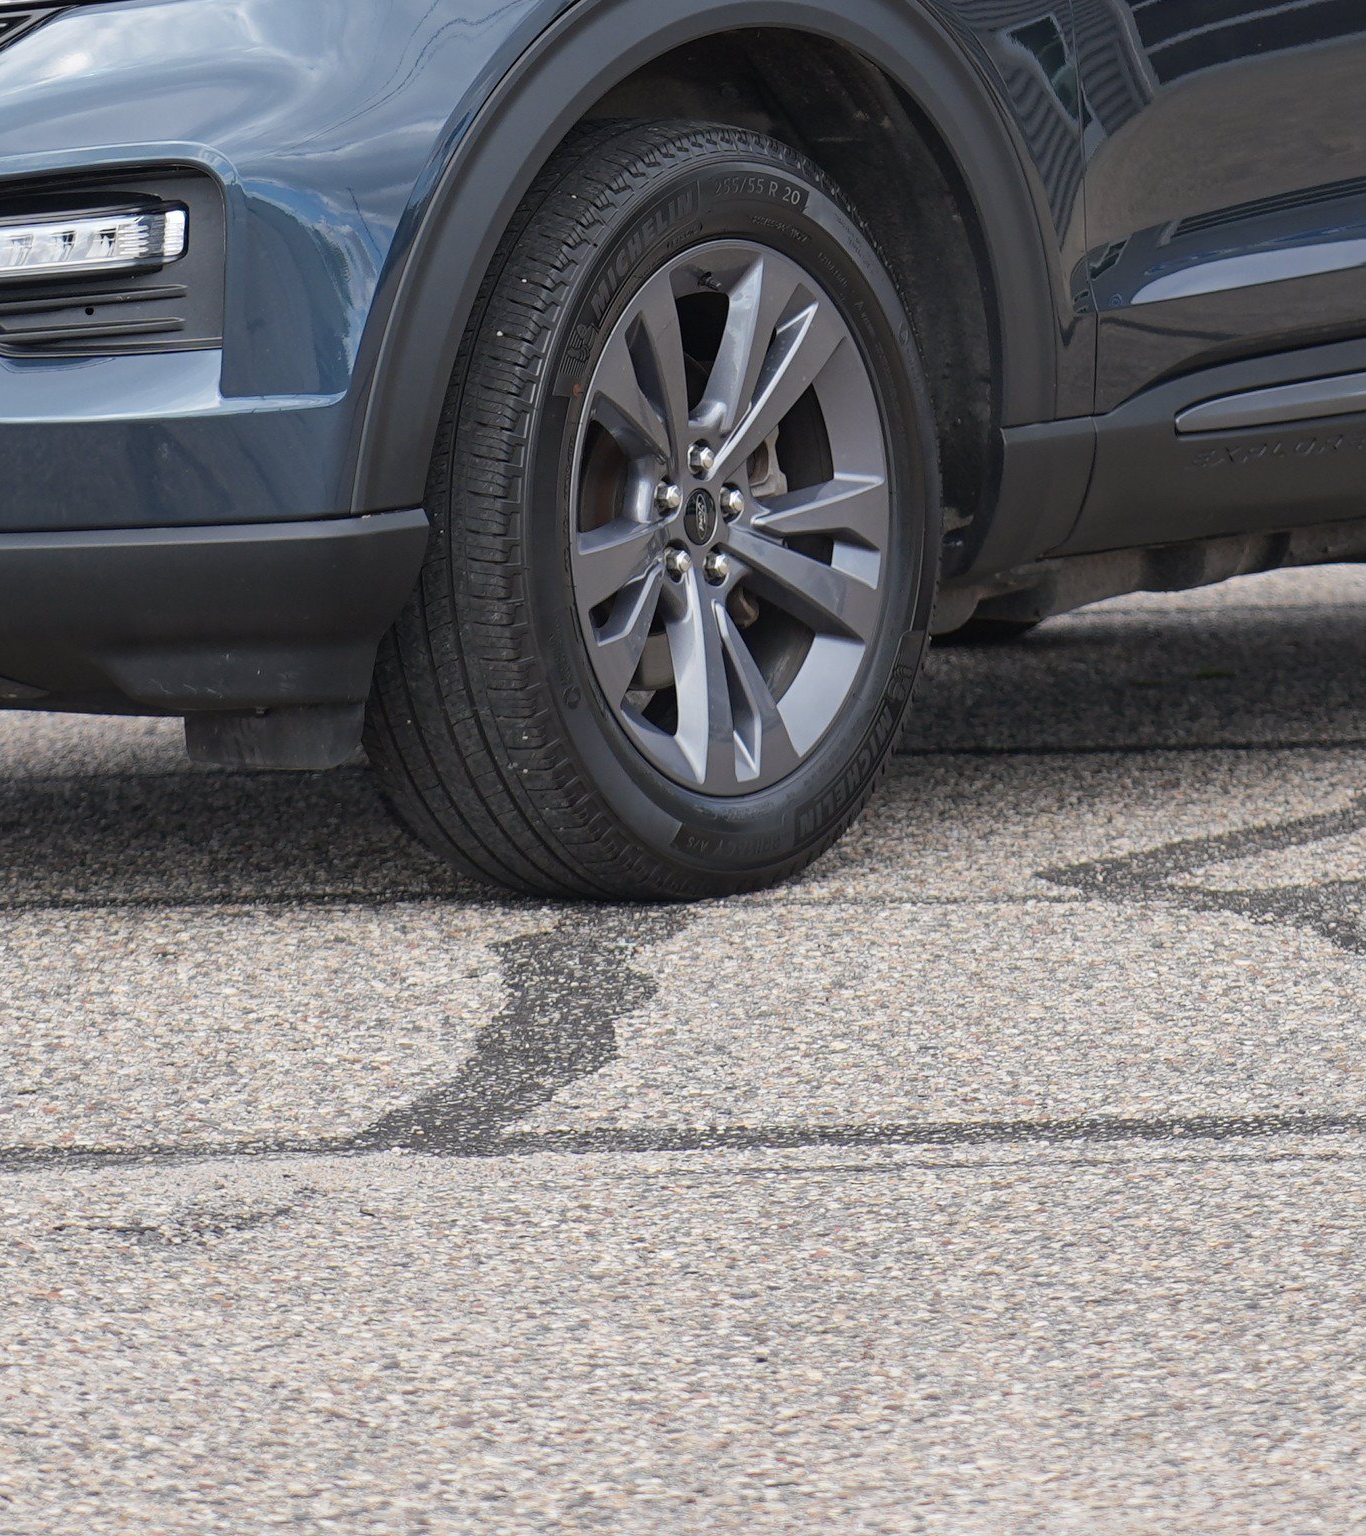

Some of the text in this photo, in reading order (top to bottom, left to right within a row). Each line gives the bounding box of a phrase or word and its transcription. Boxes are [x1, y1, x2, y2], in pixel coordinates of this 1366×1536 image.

[590, 184, 697, 320] MICHELIN
[715, 177, 801, 206] 255/55 R 20
[797, 704, 897, 838] MICHELIN
